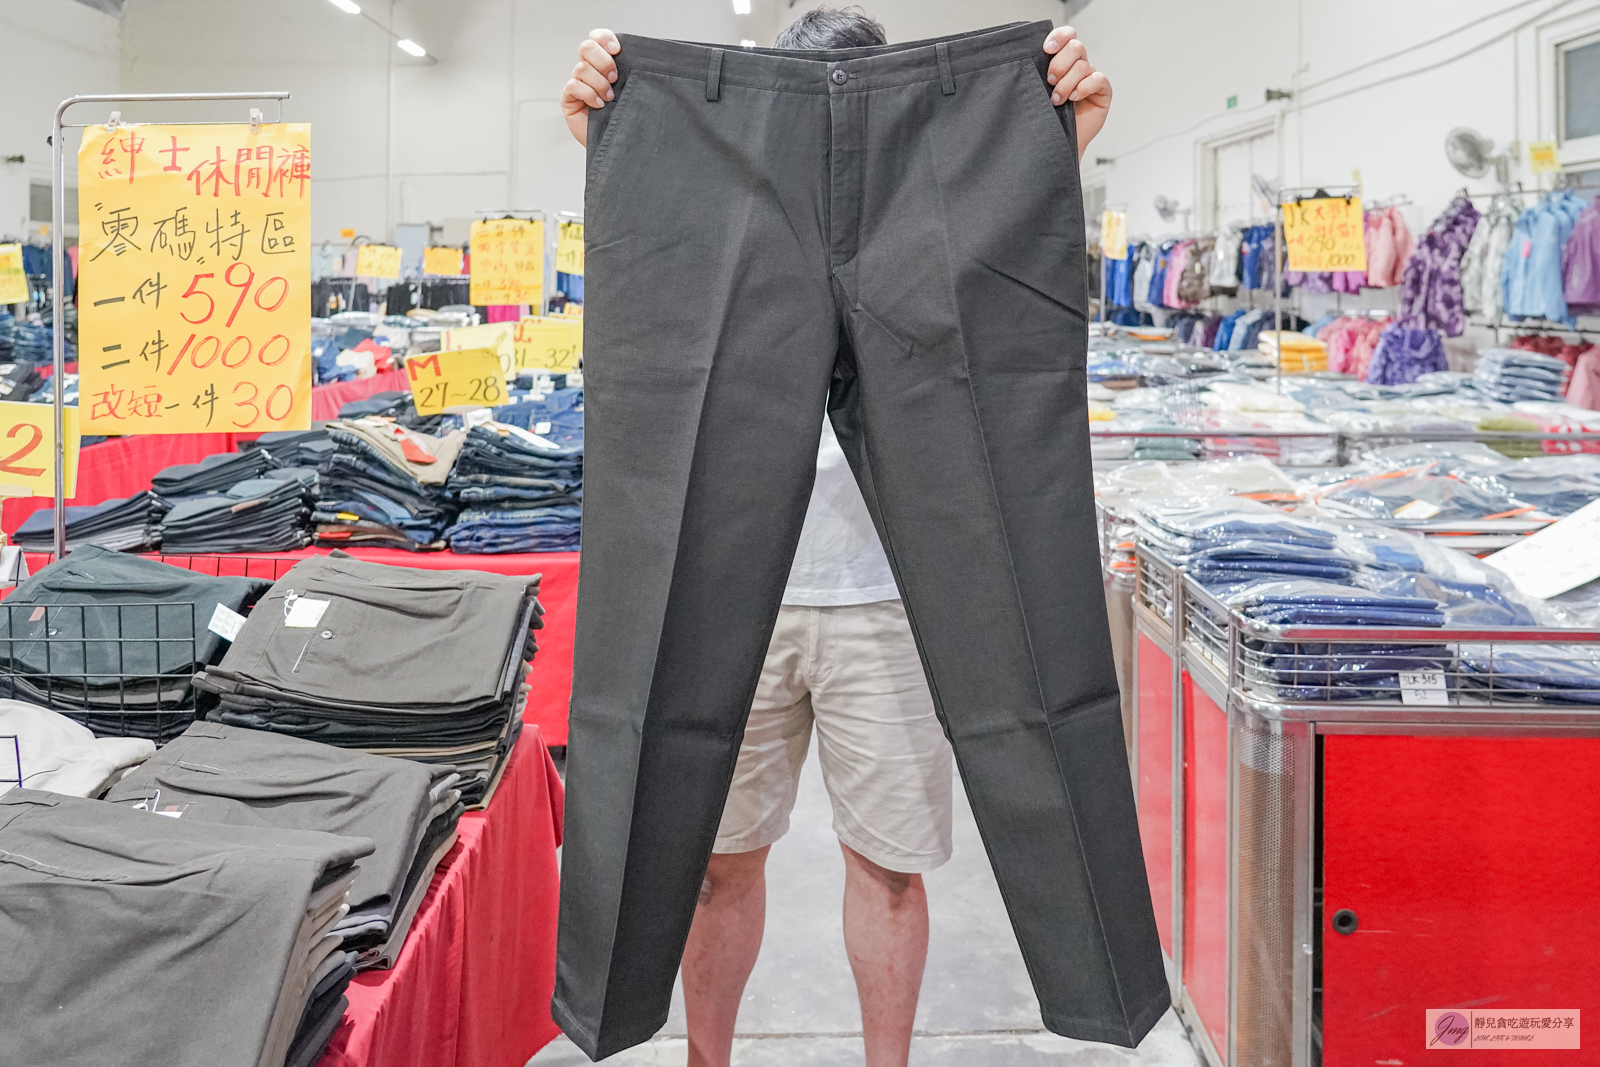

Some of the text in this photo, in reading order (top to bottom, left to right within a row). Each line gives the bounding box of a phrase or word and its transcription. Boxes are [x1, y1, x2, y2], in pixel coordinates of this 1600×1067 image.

[180, 261, 290, 328] 590
[166, 333, 291, 376] 1000
[407, 354, 441, 381] M
[231, 381, 294, 429] 30
